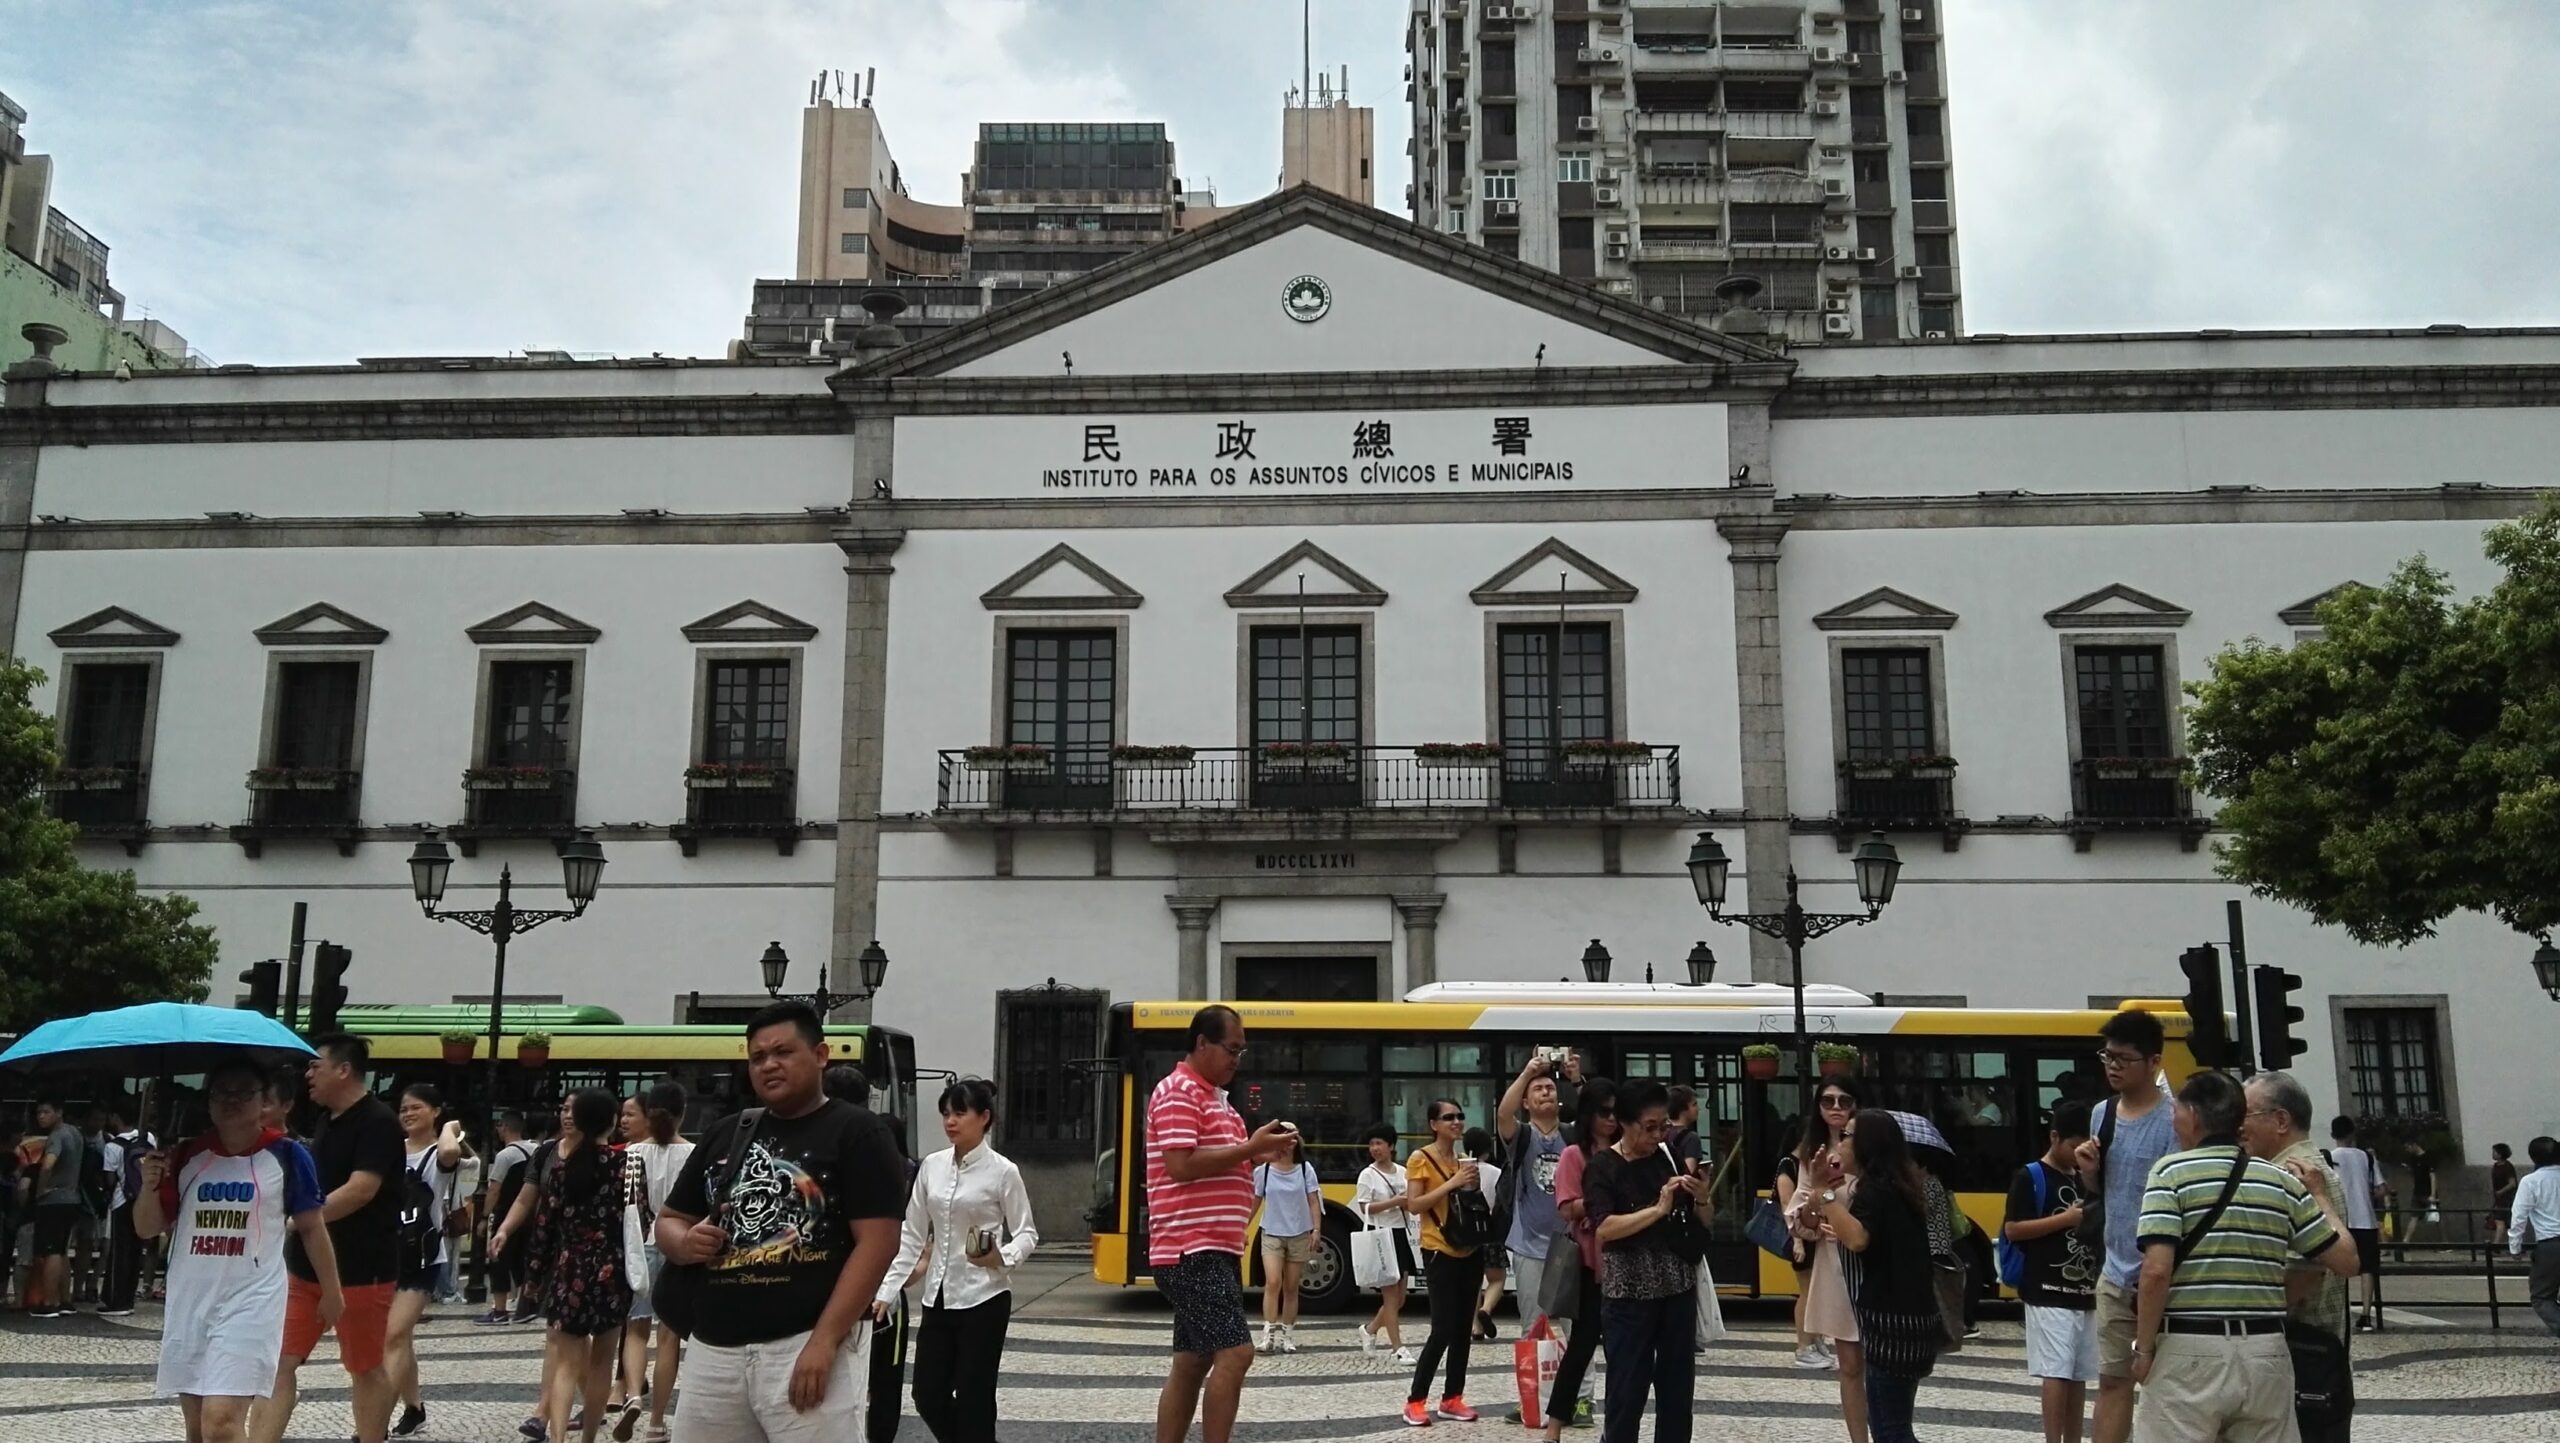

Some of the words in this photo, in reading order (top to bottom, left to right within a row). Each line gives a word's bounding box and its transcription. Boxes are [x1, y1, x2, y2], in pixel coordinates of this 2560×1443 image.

[1083, 417, 1532, 462] 民政總署
[1043, 469, 1138, 487] INSTITUTO
[1150, 468, 1197, 486] PARA
[1210, 467, 1236, 485] OS
[1249, 466, 1348, 485] ASSUNTOS
[1361, 461, 1435, 484] CÍVICOS
[1449, 464, 1459, 482] E
[1472, 462, 1573, 481] MUNICIPAIS
[1255, 853, 1354, 869] MDCCCLXXVI
[198, 1181, 255, 1202] GOOD
[195, 1209, 250, 1230] NEWYORK
[190, 1235, 246, 1256] FASHION
